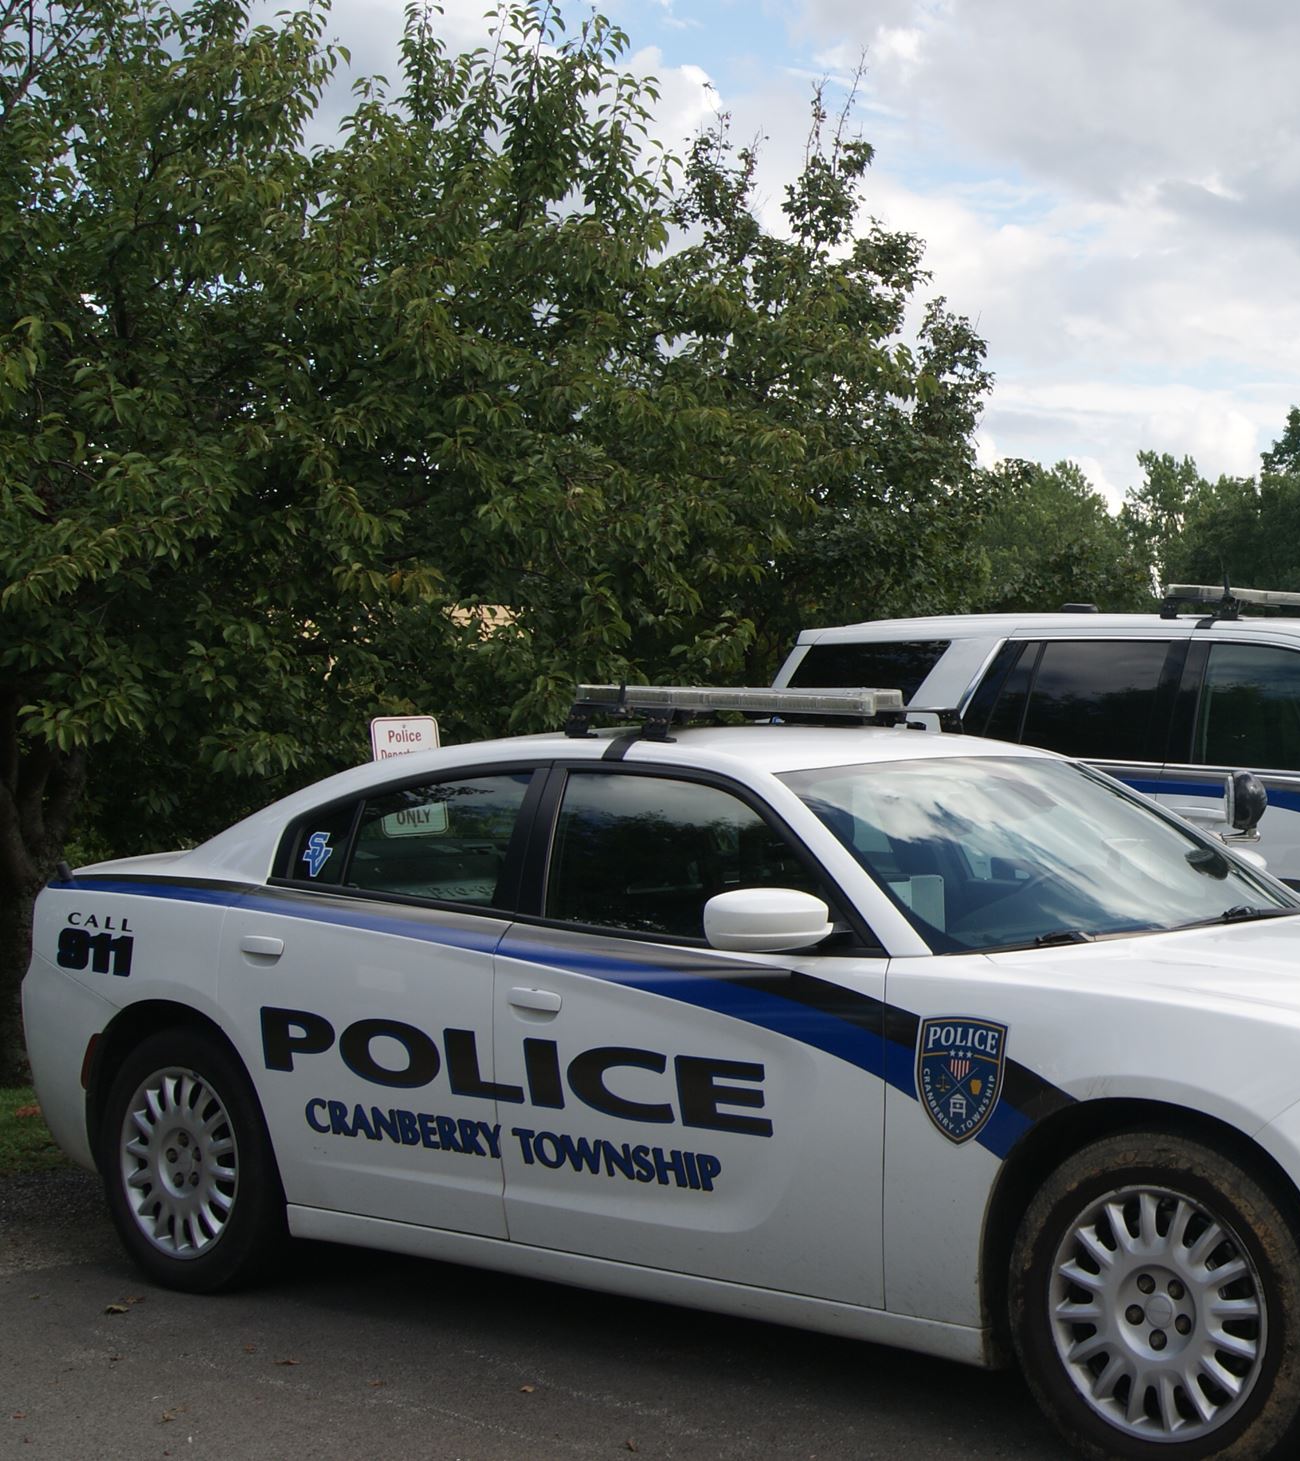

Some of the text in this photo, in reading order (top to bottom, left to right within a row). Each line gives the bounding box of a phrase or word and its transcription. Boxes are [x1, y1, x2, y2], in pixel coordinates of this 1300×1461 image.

[388, 729, 421, 743] Police
[396, 808, 431, 826] ONLY
[68, 912, 133, 932] CALL
[57, 928, 134, 977] 911
[927, 1026, 998, 1054] POLICE
[260, 1006, 774, 1138] POLICE
[923, 1068, 996, 1132] CRANBERRY TOWNSHIP
[305, 1098, 722, 1192] CRANBERRY TOWNSHIP
